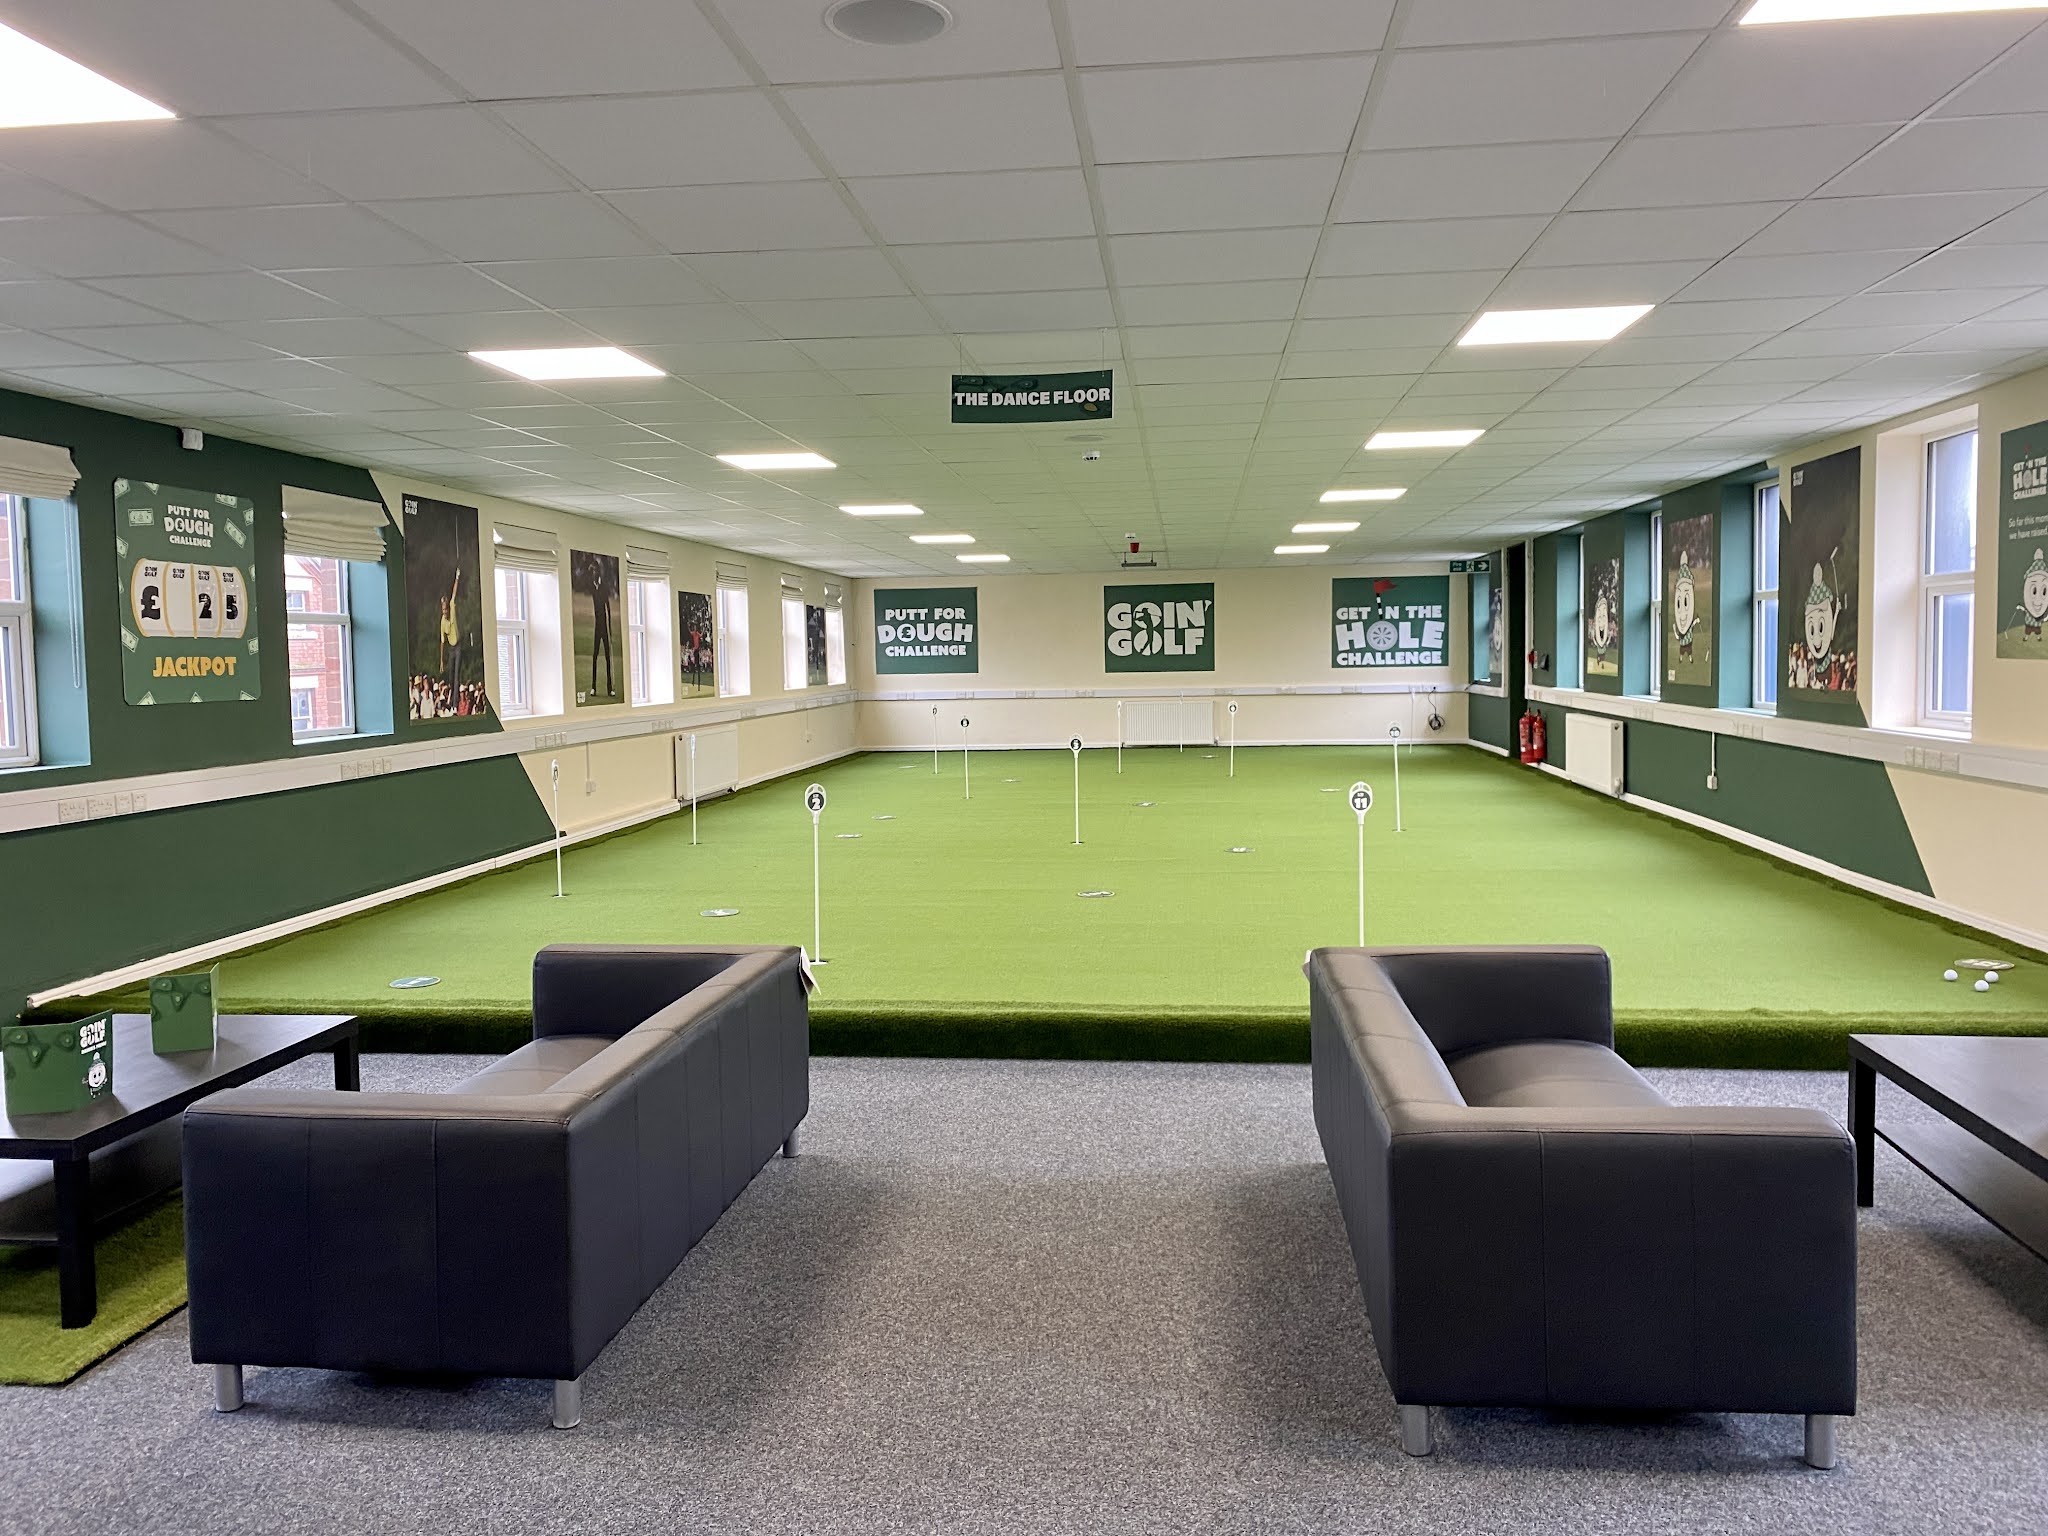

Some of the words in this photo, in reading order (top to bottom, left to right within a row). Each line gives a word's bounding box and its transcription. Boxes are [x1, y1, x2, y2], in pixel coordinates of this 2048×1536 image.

[954, 392, 989, 406] THE
[991, 391, 1051, 406] DANCE
[1053, 387, 1111, 405] FLOOR
[2013, 466, 2048, 491] HOLE
[167, 504, 191, 517] PUTT
[193, 508, 210, 520] FOR
[164, 517, 214, 538] DOUGH
[169, 534, 212, 548] CHALLENGE
[141, 585, 161, 620] £
[198, 592, 212, 619] 2
[226, 595, 238, 620] 5
[885, 608, 929, 622] PUTT
[934, 607, 967, 621] FOR
[1107, 599, 1212, 630] GOIN'
[1336, 606, 1371, 620] GET
[1405, 605, 1442, 619] THE
[877, 622, 974, 644] DOUGH
[1107, 628, 1205, 657] GOLF
[1335, 620, 1445, 651] HOLE
[885, 644, 967, 657] CHALLENGE
[1336, 650, 1442, 666] CHALLENGE
[153, 656, 237, 678] JACKPOT
[811, 797, 821, 809] 2
[1354, 797, 1368, 809] 11
[80, 1029, 105, 1048] GOLF
